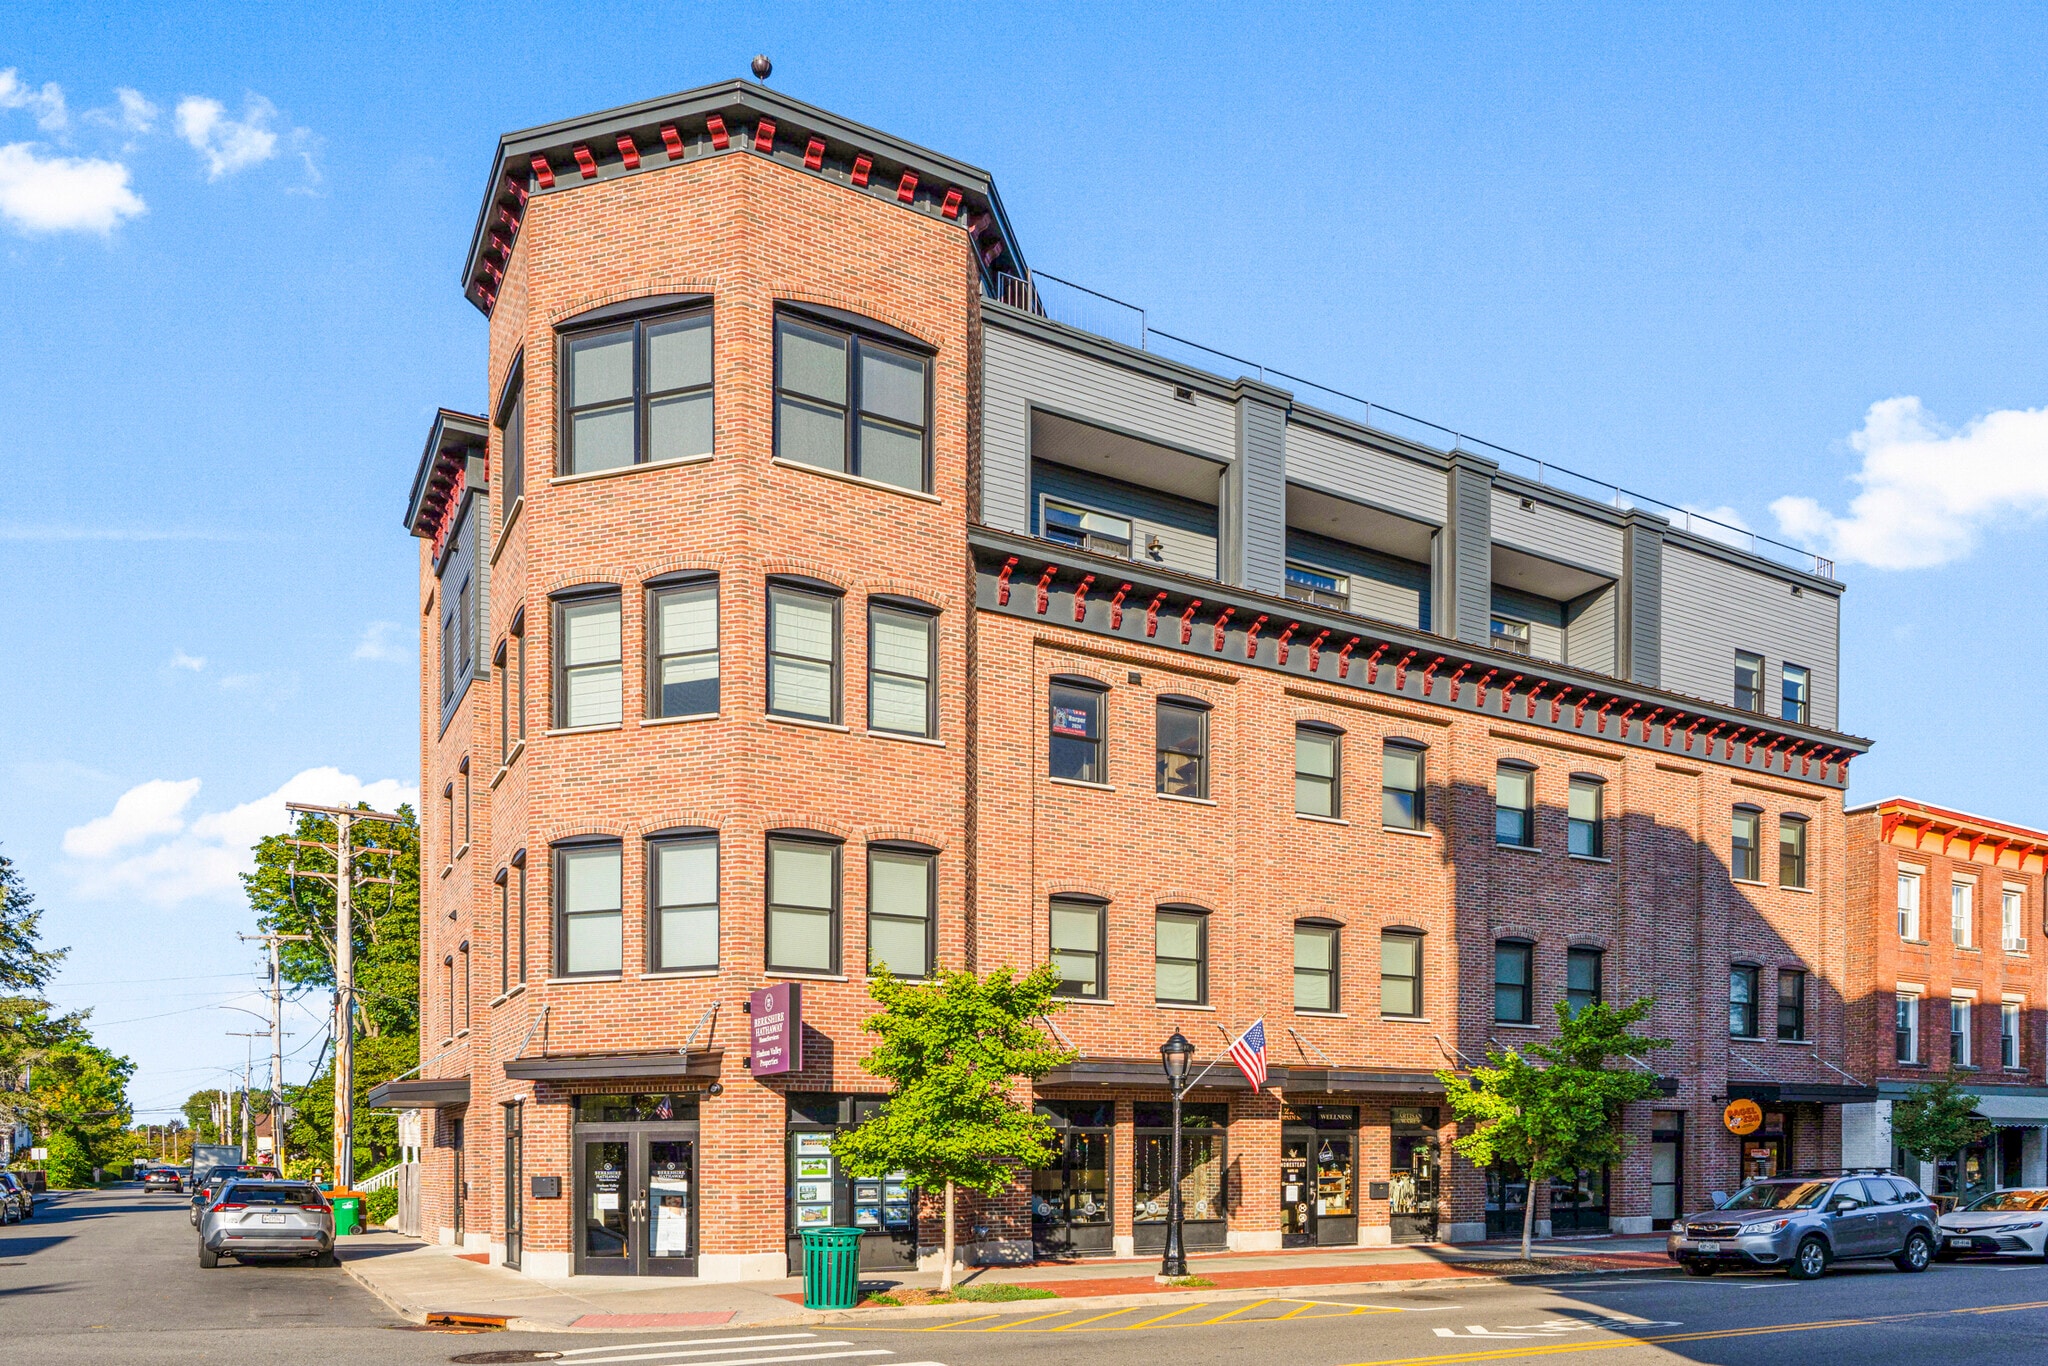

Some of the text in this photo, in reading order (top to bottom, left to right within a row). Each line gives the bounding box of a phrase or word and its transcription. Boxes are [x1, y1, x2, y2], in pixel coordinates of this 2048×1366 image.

[754, 1012, 784, 1028] BERKSHIRE
[755, 1022, 784, 1037] HATHAWAY
[759, 1034, 779, 1043] HomeServices
[756, 1046, 782, 1058] Hudson Valley
[760, 1058, 778, 1068] Properties
[1320, 1113, 1352, 1121] WELLNESS
[1727, 1107, 1757, 1117] BAGEL
